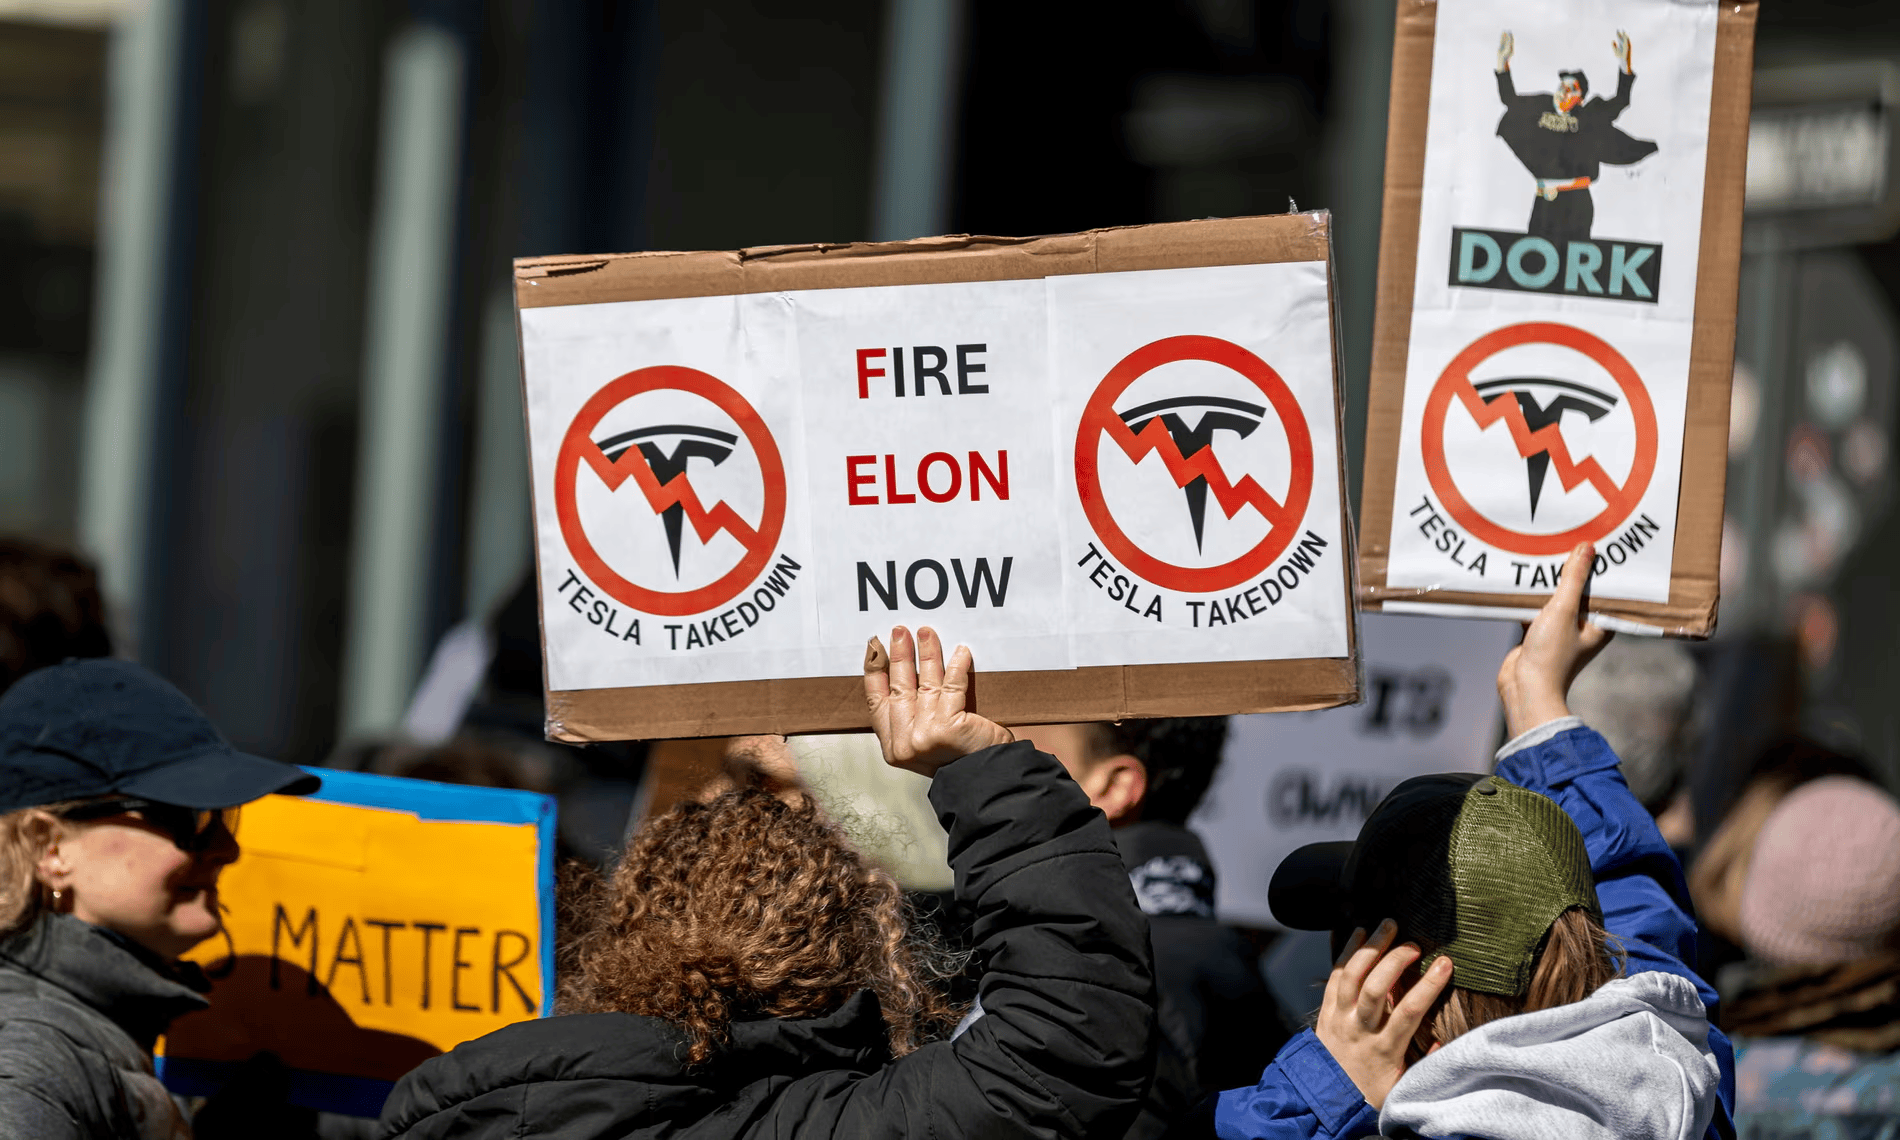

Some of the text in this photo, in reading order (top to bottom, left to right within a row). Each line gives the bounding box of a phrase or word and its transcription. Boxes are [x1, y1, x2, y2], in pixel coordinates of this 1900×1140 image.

[1458, 231, 1655, 298] DORK
[857, 344, 989, 398] FIRE
[847, 450, 1009, 505] ELON
[1078, 531, 1328, 627] TESLA TAKEDOWN
[1409, 495, 1660, 588] TESLA TAKDOWN
[558, 554, 802, 650] TESLA TAKEDOWN
[857, 557, 1013, 611] NOW
[269, 901, 536, 1013] MATTER
